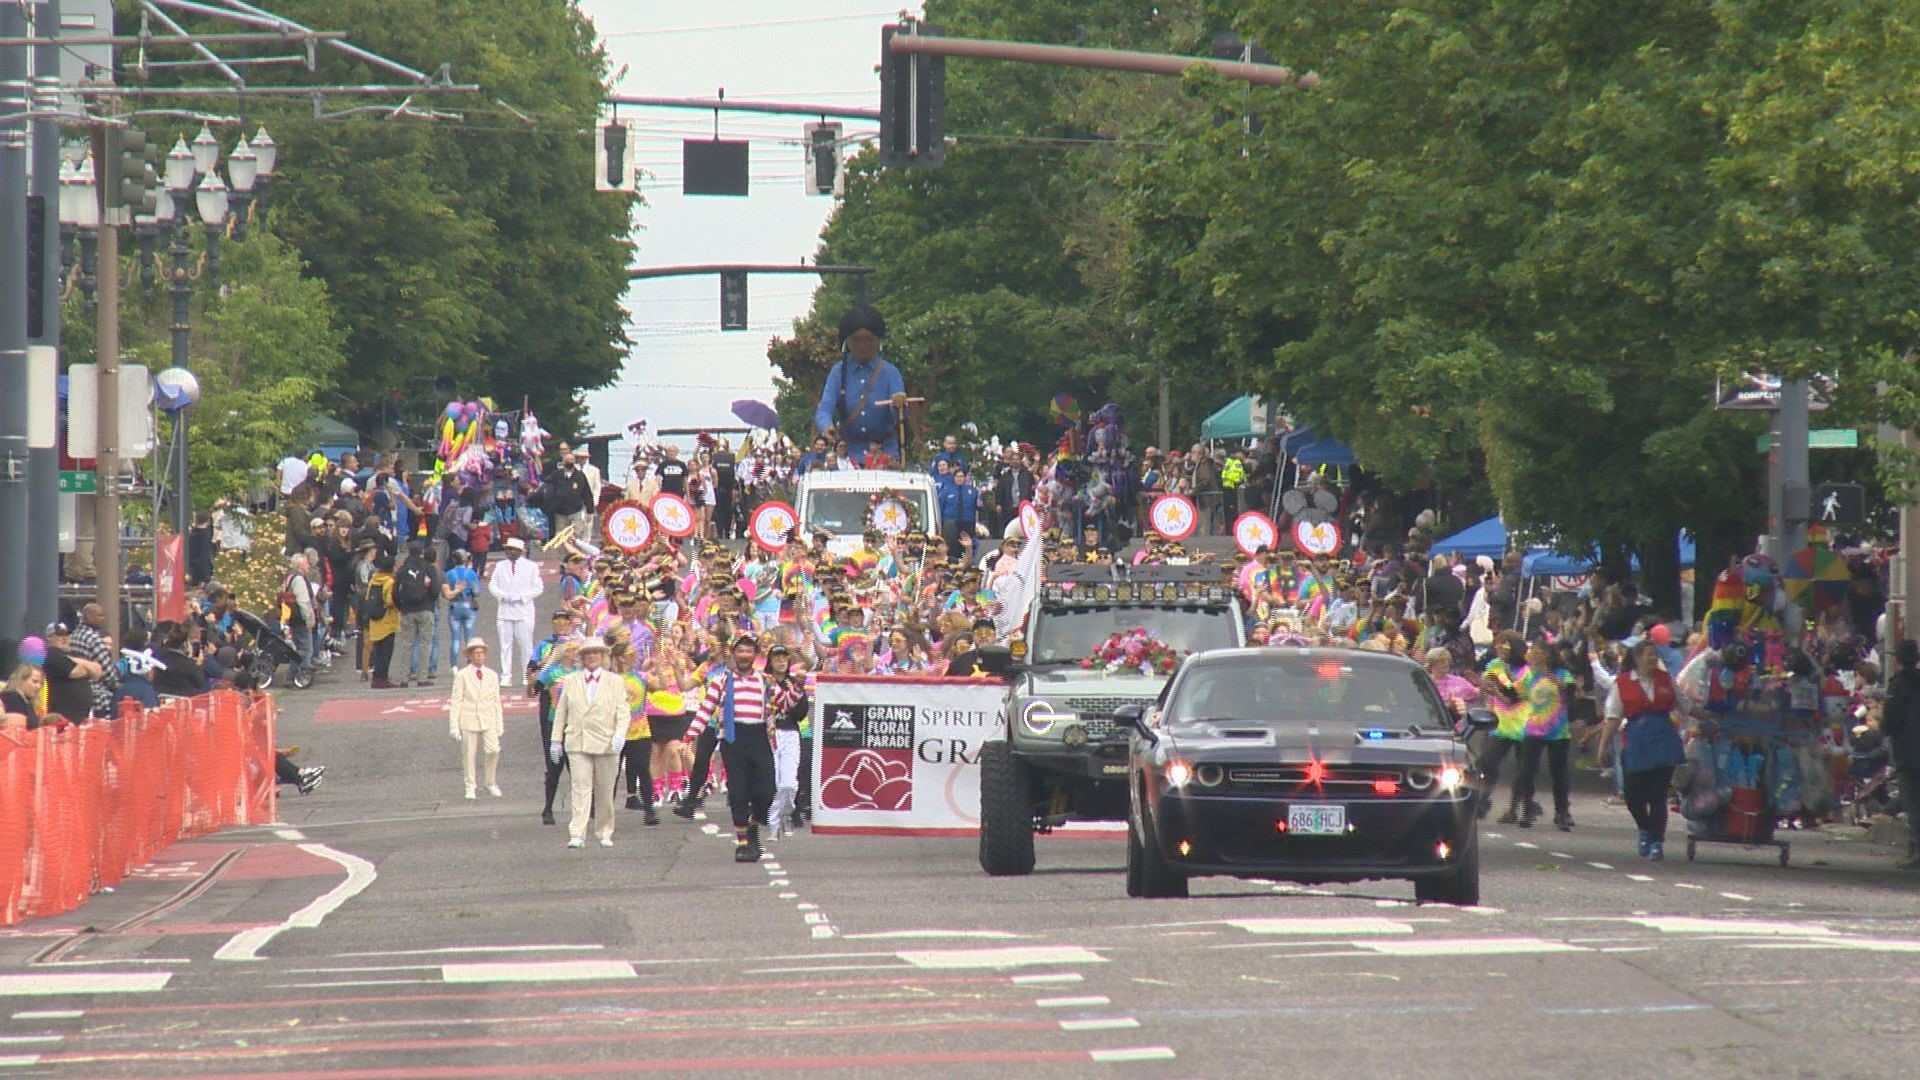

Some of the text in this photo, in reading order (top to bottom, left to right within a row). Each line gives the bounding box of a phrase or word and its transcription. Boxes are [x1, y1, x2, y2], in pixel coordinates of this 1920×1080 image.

[867, 706, 912, 720] GRAND
[921, 708, 987, 727] SPIRIT
[868, 721, 911, 735] FLORAL
[868, 735, 911, 748] PARADE
[1292, 812, 1313, 828] 686
